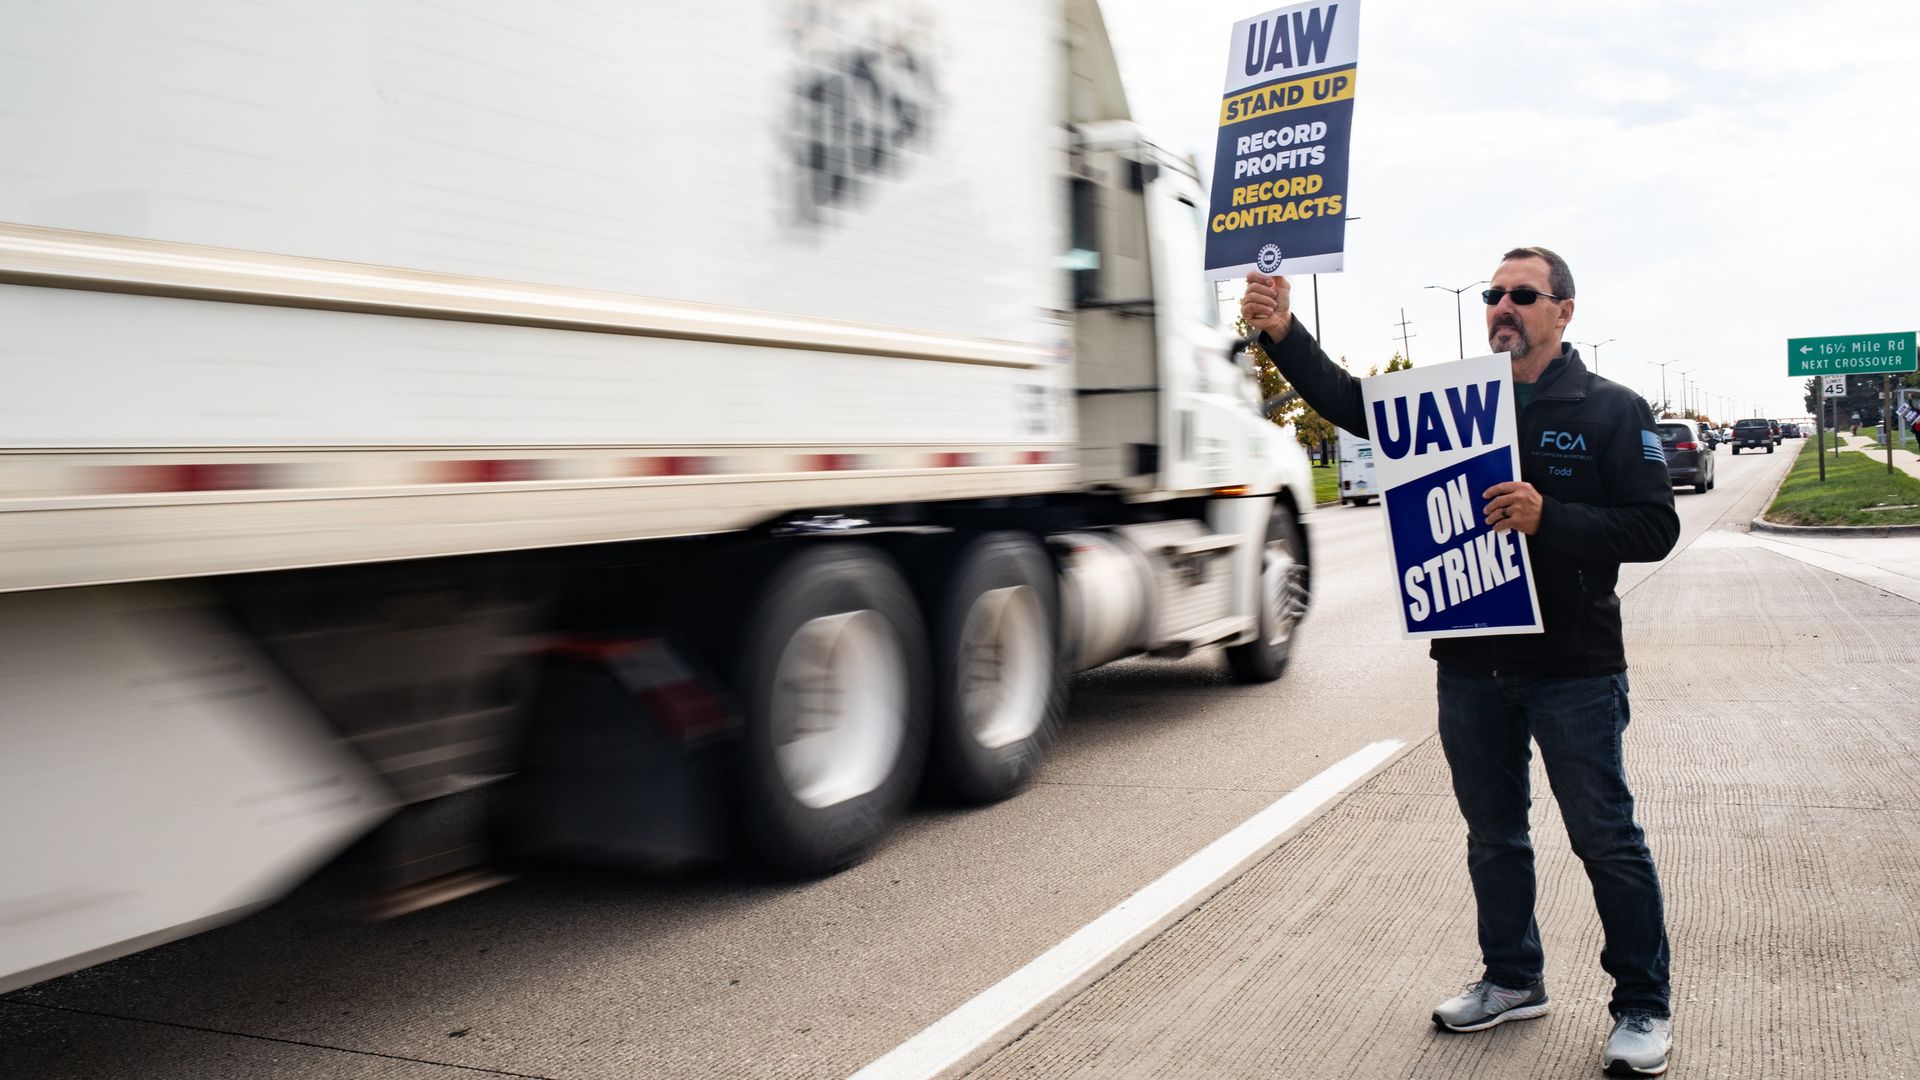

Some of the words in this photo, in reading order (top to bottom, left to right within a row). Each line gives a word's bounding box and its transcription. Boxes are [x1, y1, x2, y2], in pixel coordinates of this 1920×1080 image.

[1245, 4, 1339, 77] UAW
[1226, 85, 1304, 120] STAND
[1313, 75, 1348, 100] UP
[1236, 121, 1327, 156] RECORD
[1234, 145, 1326, 180] PROFITS
[1232, 174, 1323, 207] RECORD
[1212, 195, 1343, 233] CONTRACTS
[1801, 359, 1829, 370] NEXT
[1834, 355, 1902, 368] CROSSOVER
[1852, 341, 1881, 353] Mile
[1888, 339, 1905, 351] Rd
[1824, 384, 1844, 394] 45
[1373, 380, 1501, 460] UAW
[1540, 430, 1587, 451] FCA
[1549, 465, 1572, 477] Todd
[1426, 473, 1476, 545] ON
[1404, 526, 1521, 622] STRIKE
